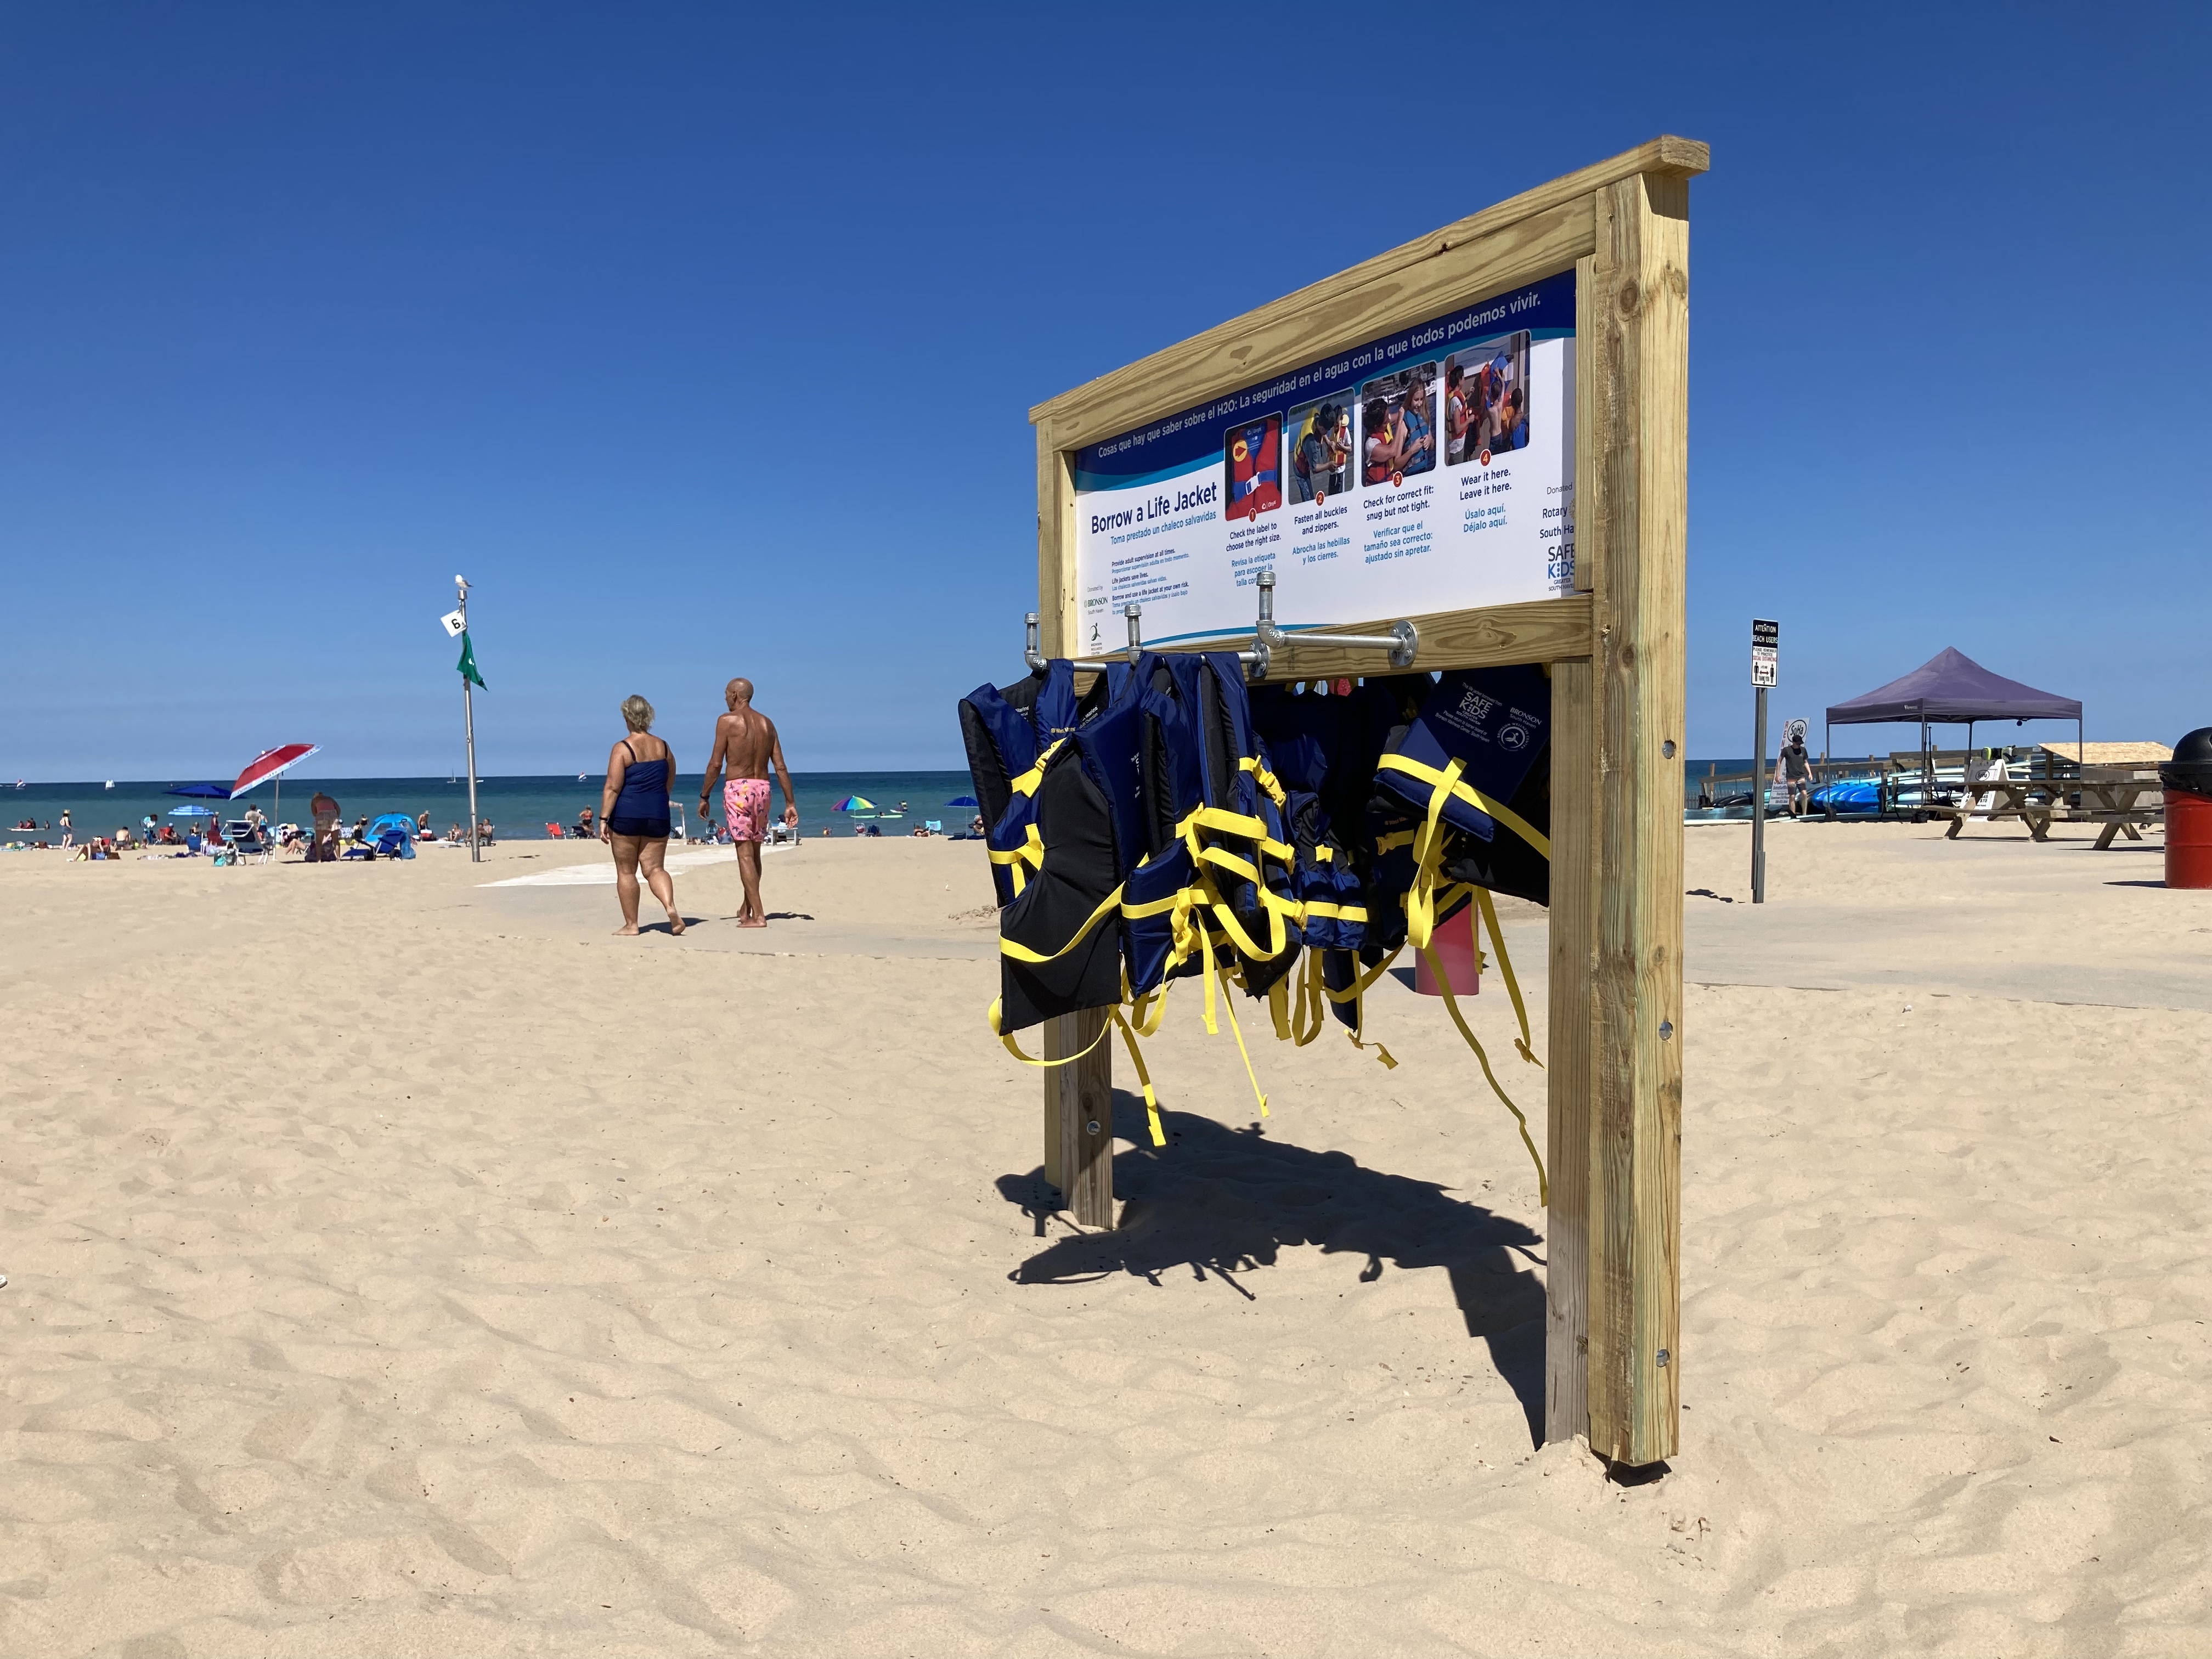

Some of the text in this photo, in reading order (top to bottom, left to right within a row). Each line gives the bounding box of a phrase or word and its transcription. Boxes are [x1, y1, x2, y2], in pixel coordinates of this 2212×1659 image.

[1099, 292, 1541, 458] Cosas que hay que saber sobre el H2O: La seguridad en el agua con la que todos podemos vivir.
[1482, 454, 1488, 462] 4
[1395, 475, 1400, 484] 3
[1461, 469, 1510, 486] Wear it here.
[1460, 483, 1512, 500] Leave it here.
[1547, 482, 1573, 495] Donated
[1318, 494, 1322, 504] 2
[1363, 486, 1434, 509] Check for correct fit:
[1092, 482, 1216, 534] Borrow a Life Jacket
[1295, 515, 1313, 524] Fasten
[1324, 506, 1347, 517] buckles
[1367, 500, 1430, 521] snug but not tight.
[1465, 503, 1505, 520] Úsalo aquí.
[1543, 506, 1568, 518] Rotary
[1110, 535, 1125, 545] Toma
[1127, 527, 1151, 543] prestado
[1161, 520, 1183, 532] chaleco
[1186, 511, 1216, 526] salvavidas
[1230, 529, 1245, 539] Check
[1257, 523, 1269, 533] label
[1302, 522, 1339, 535] and zippers.
[1374, 521, 1422, 538] Verificar que el
[1464, 516, 1507, 532] Déjalo aquí.
[1540, 524, 1574, 538] South Ha
[1226, 534, 1281, 551] choose the right size.
[1293, 544, 1316, 555] Abrocha
[1327, 537, 1350, 548] hebillas
[1364, 540, 1388, 551] tamaño
[1403, 532, 1432, 544] correcto:
[1135, 554, 1154, 562] supervision
[1232, 558, 1247, 567] Revisa
[1254, 552, 1276, 562] etiqueta
[1318, 552, 1338, 561] cierres.
[1365, 545, 1431, 564] ajustado sin apretar.
[1548, 543, 1575, 562] SAFE
[1234, 569, 1245, 578] para
[1236, 578, 1247, 586] talla
[1088, 596, 1108, 607] BRONSON
[451, 618, 461, 629] 6
[1755, 624, 1776, 633] ATTENTION
[1464, 692, 1493, 712] SAFE
[1456, 710, 1469, 719] SOUTH
[1509, 714, 1537, 729] South Haven
[1510, 707, 1543, 725] BRONSON
[1790, 724, 1804, 736] SoHa
